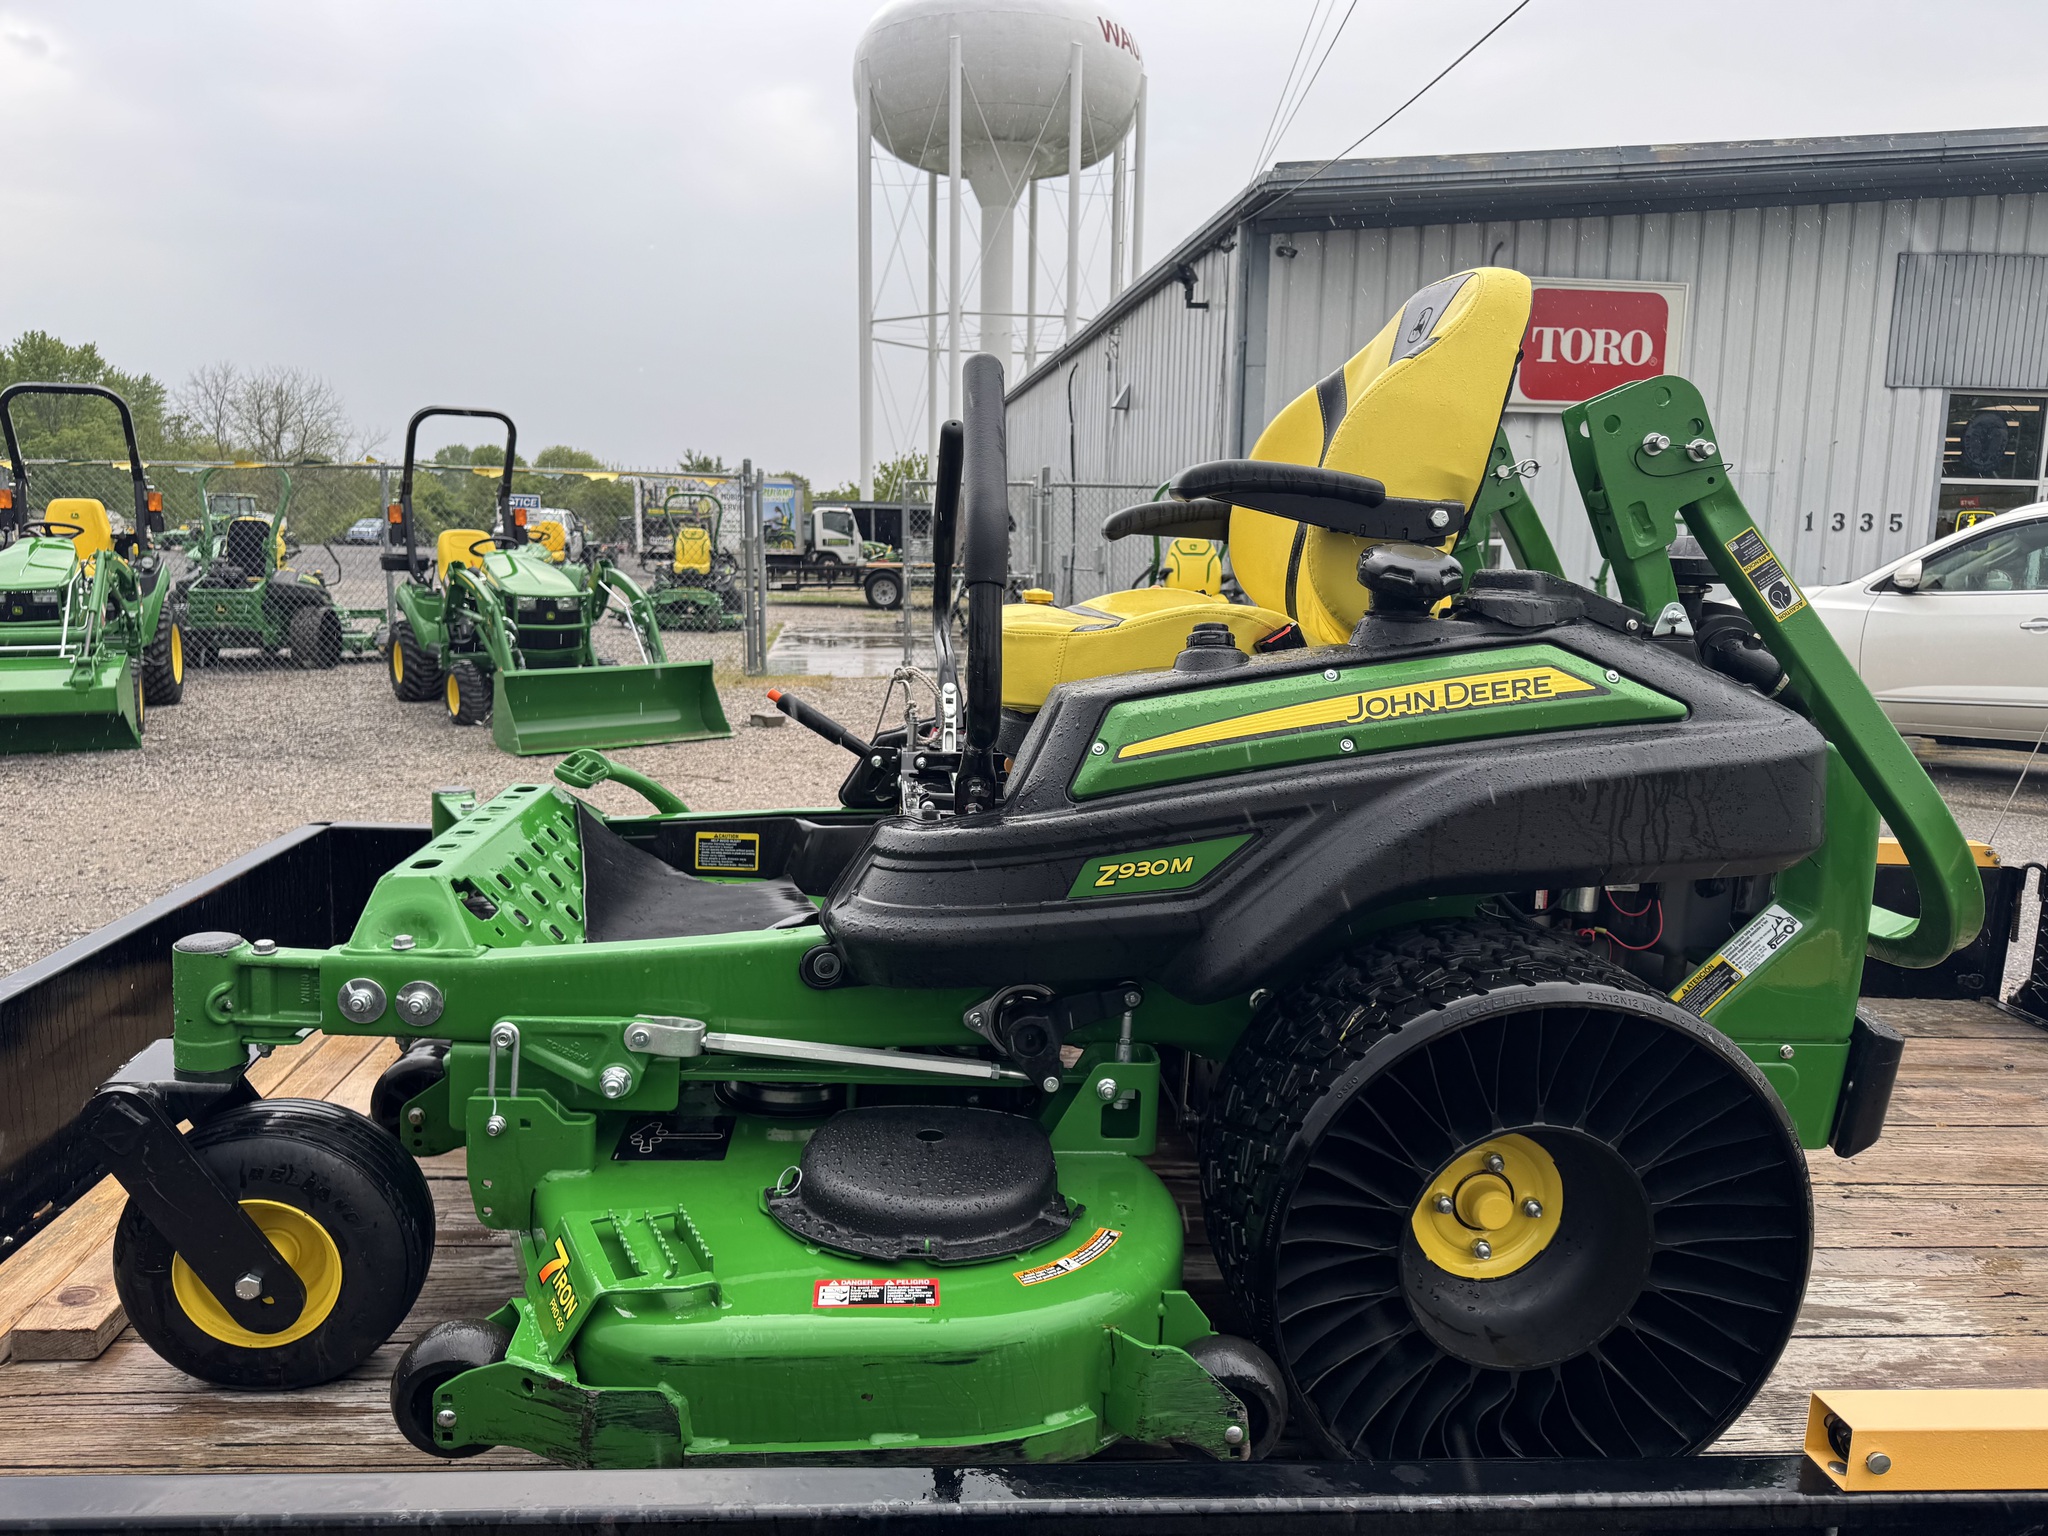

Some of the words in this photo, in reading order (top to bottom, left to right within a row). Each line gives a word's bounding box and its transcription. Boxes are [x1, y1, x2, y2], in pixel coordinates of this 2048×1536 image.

[1097, 15, 1143, 66] WAU
[1531, 326, 1653, 366] TORO
[511, 497, 537, 507] TICE
[1804, 511, 1903, 532] 1335
[1346, 689, 1436, 721] JOHN
[1444, 675, 1552, 709] DEERE
[1094, 856, 1194, 887] Z930M
[1687, 963, 1714, 990] ATENCIÓN
[1673, 1013, 1691, 1028] NOT
[549, 1297, 560, 1319] PRO
[555, 1316, 565, 1332] 60
